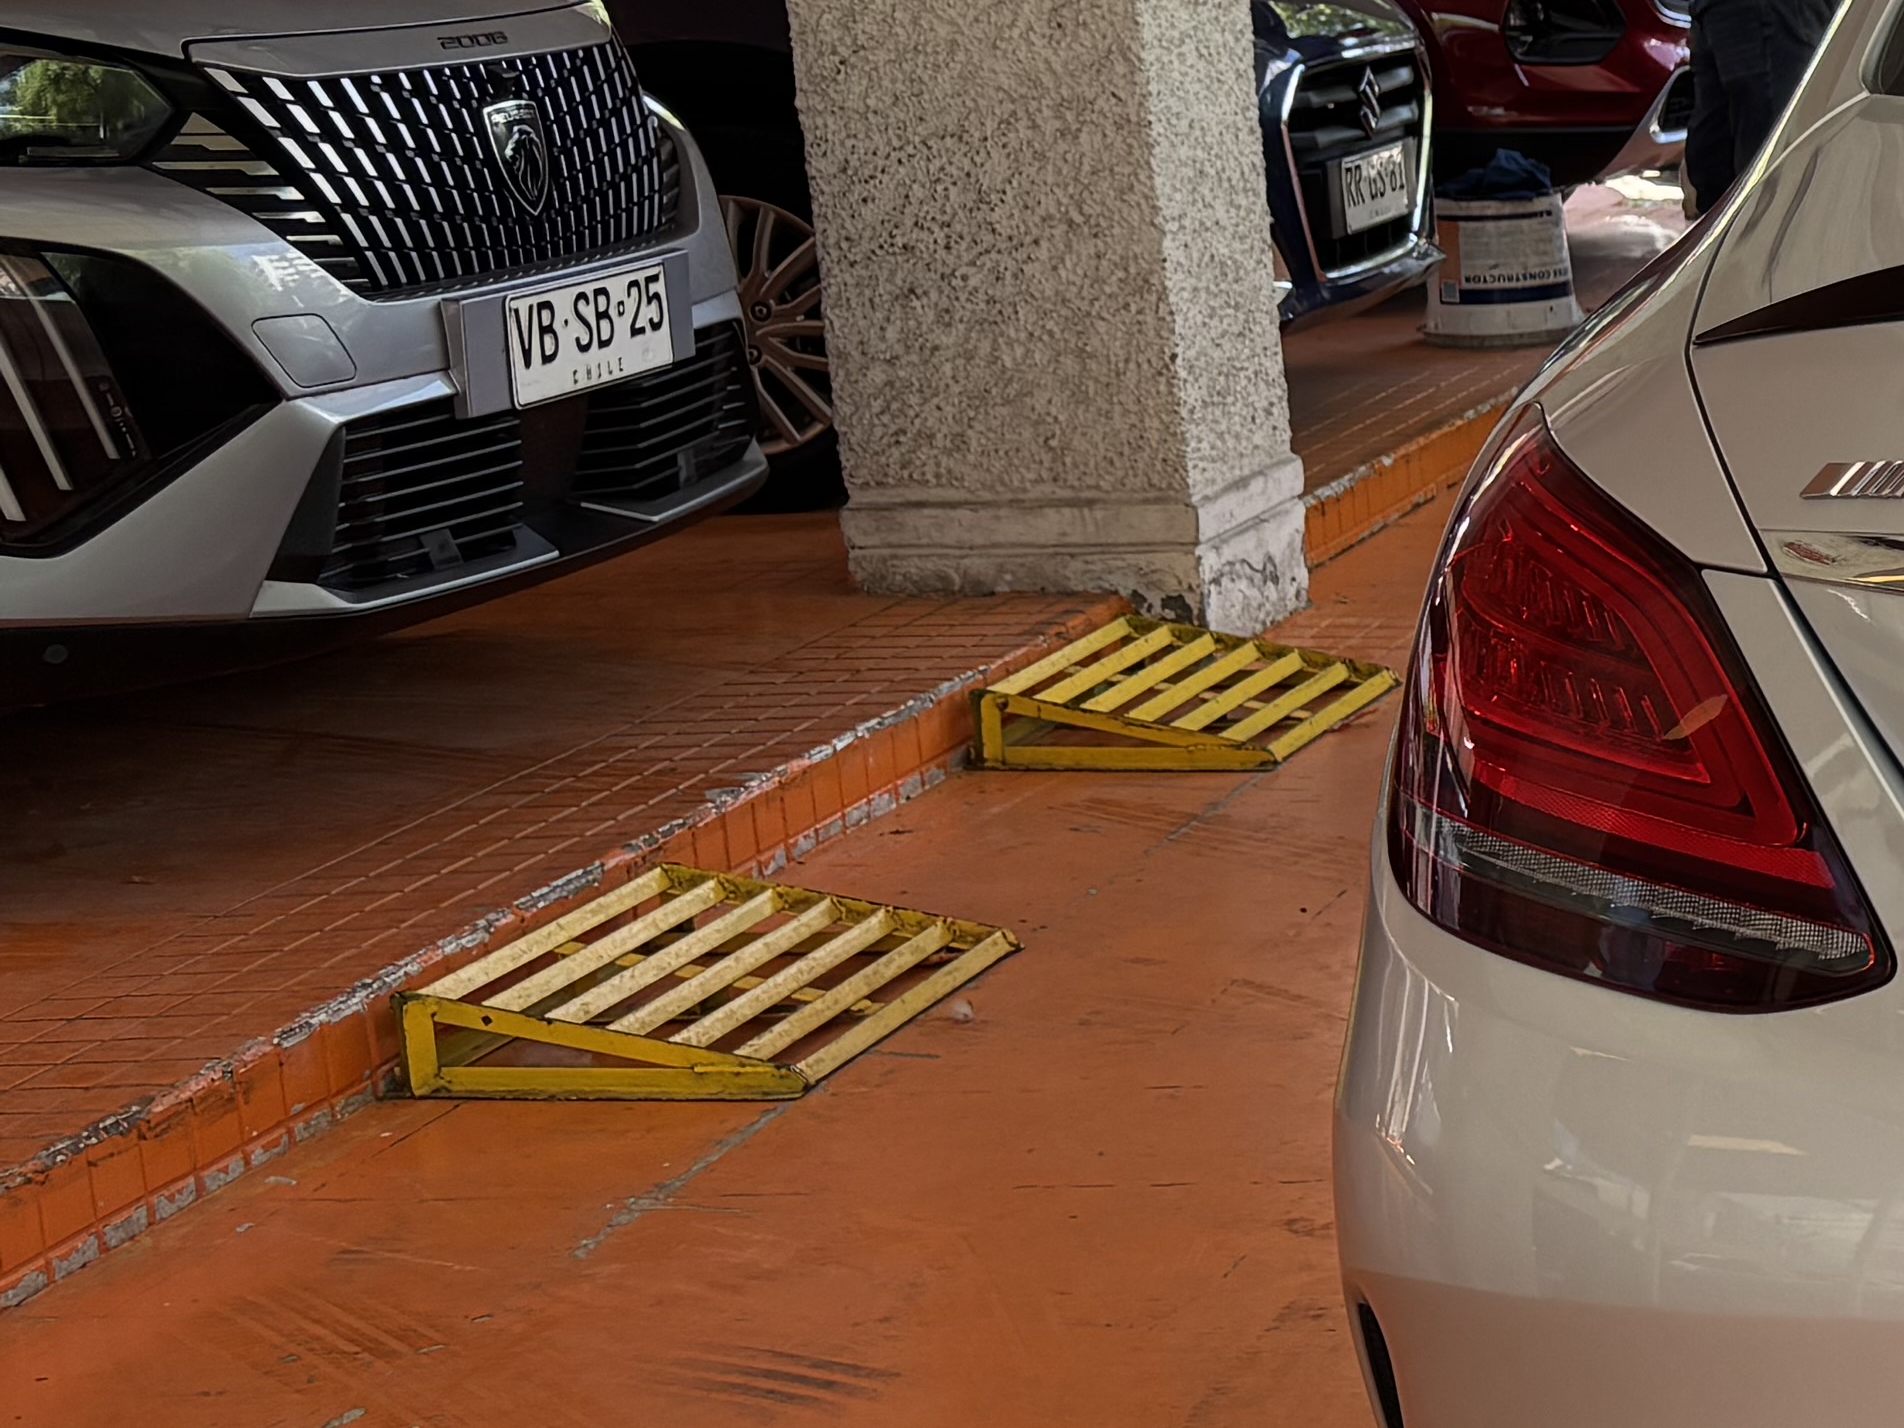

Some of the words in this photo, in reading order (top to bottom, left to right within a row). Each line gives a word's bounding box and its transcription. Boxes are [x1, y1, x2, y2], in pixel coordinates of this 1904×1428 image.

[437, 31, 508, 50] 2008
[1464, 269, 1551, 284] CONSTRUCTOR
[573, 357, 624, 384] CHILE
